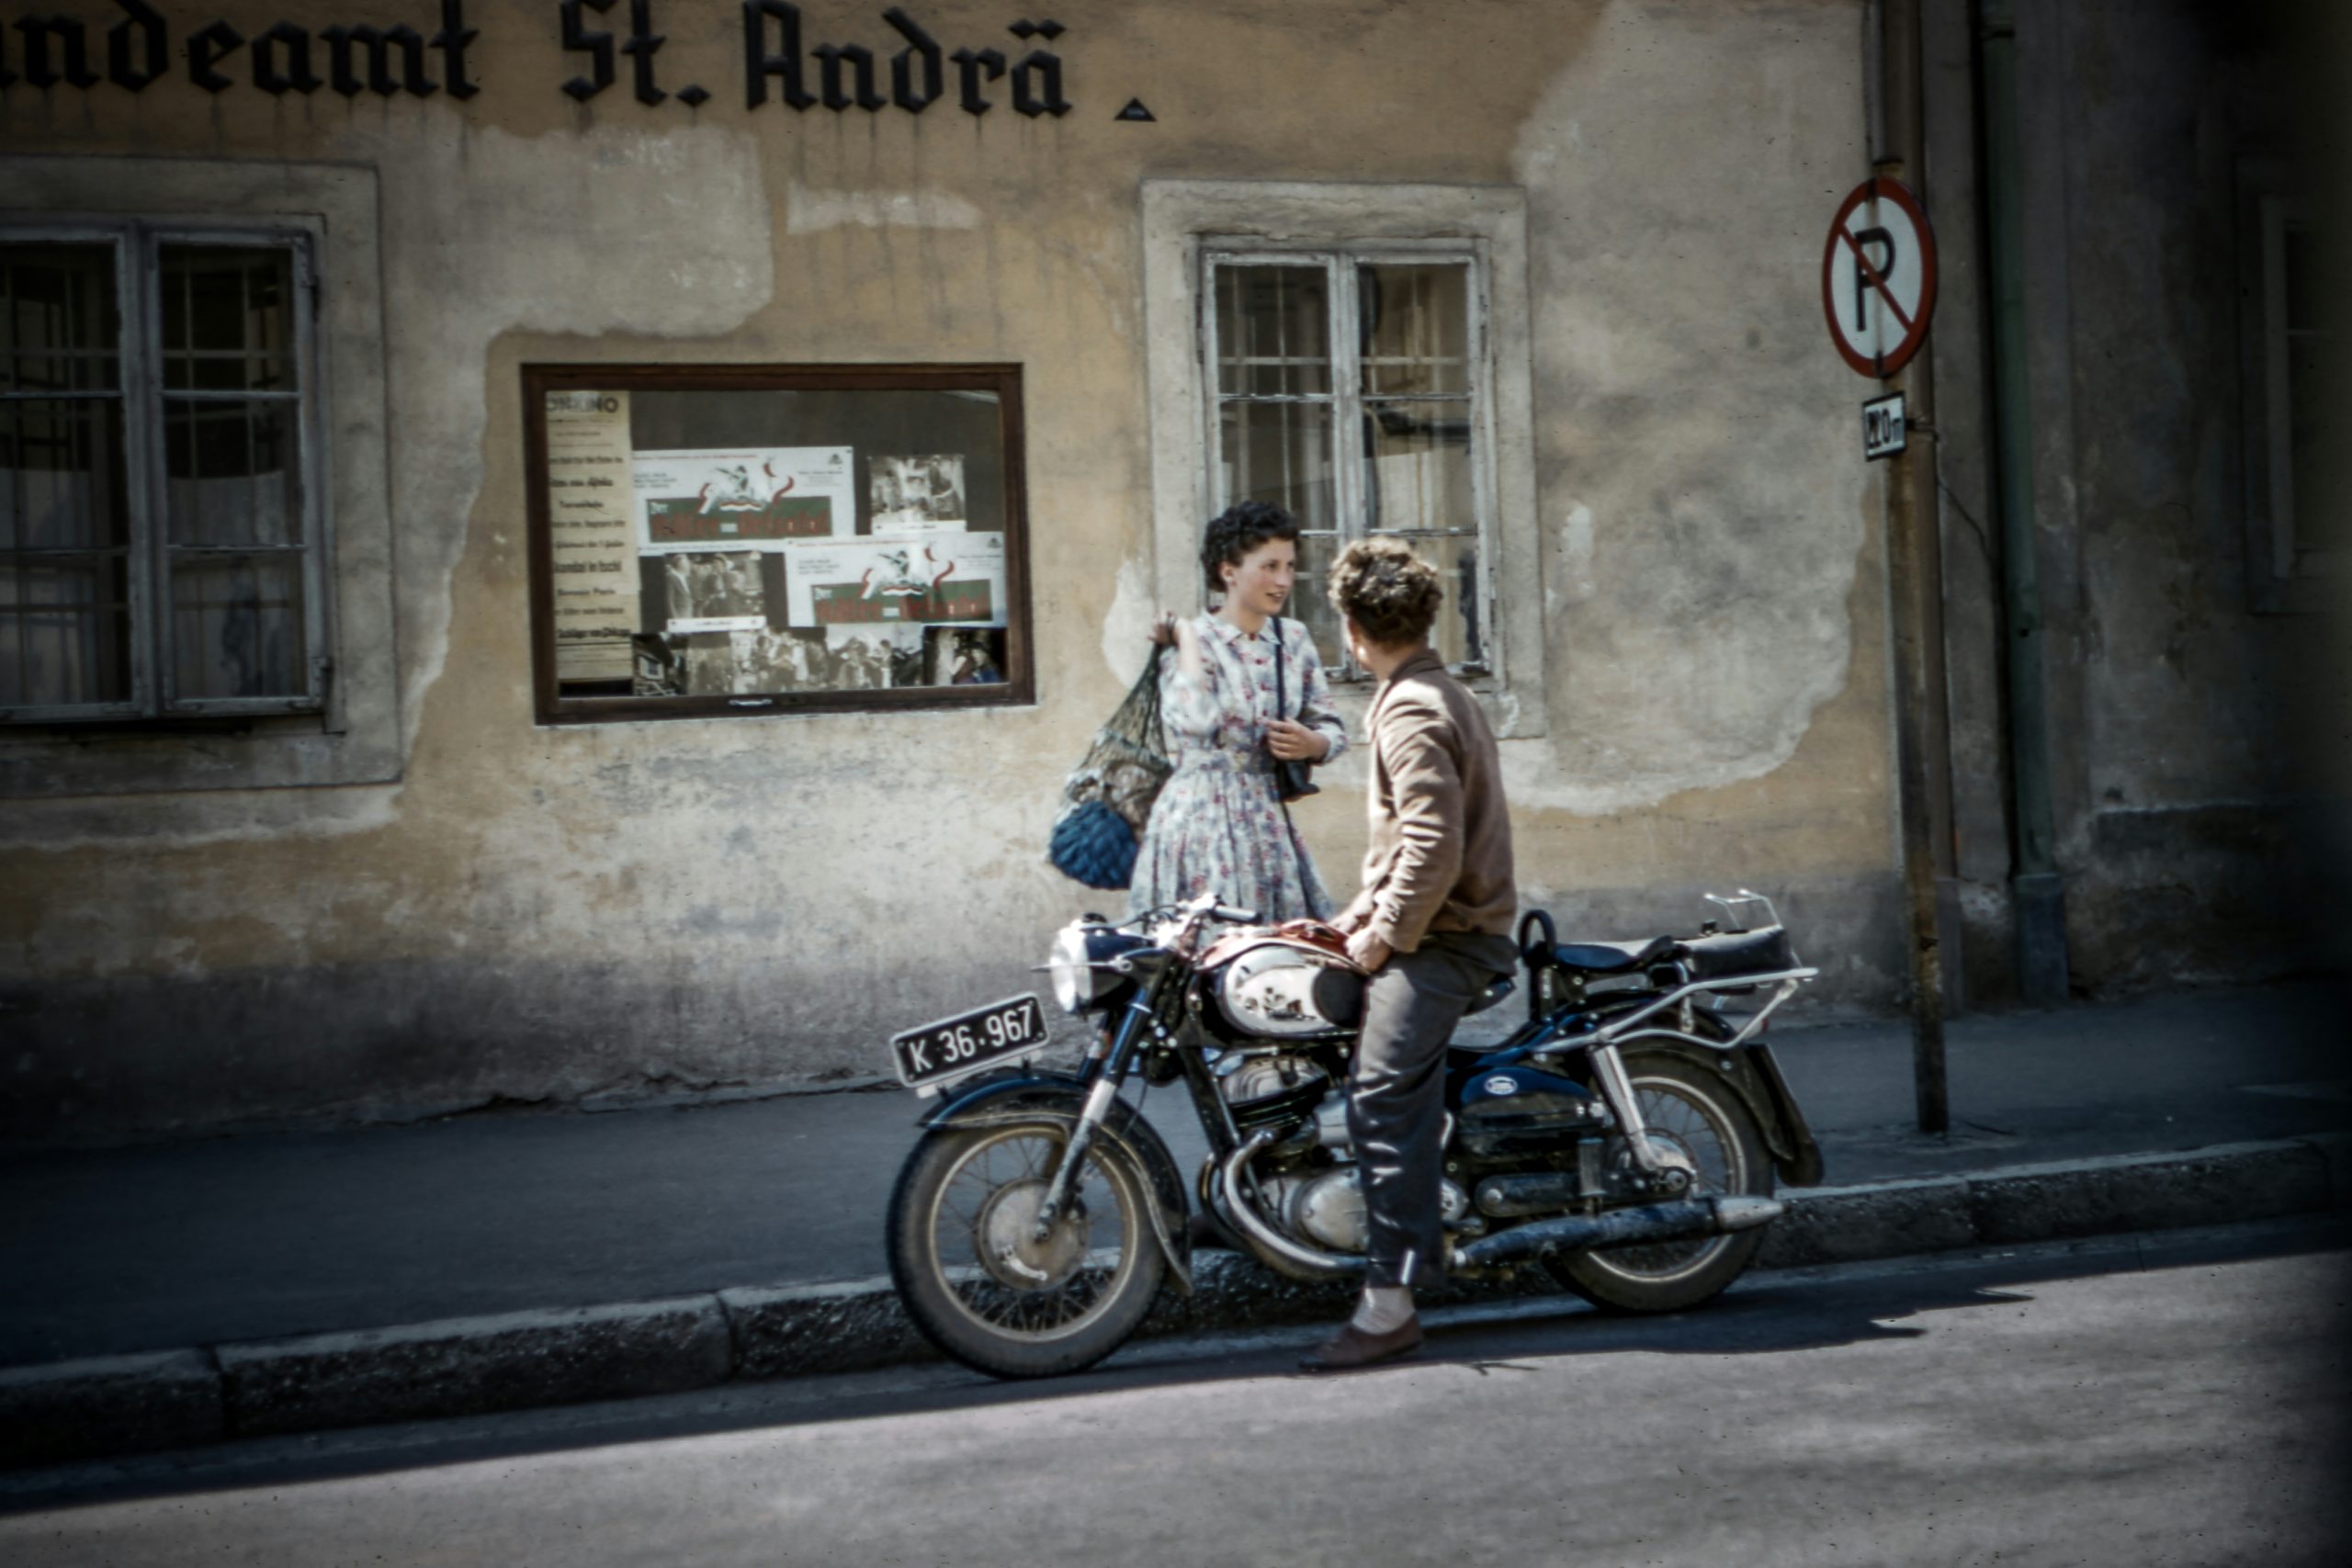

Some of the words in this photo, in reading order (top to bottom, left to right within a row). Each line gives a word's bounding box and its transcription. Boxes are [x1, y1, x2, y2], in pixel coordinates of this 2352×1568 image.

[0, 0, 481, 100] ndeamt
[560, 0, 711, 107] St.
[743, 0, 1072, 118] Andrä
[1854, 227, 1896, 333] P
[909, 1039, 933, 1073] K
[937, 1004, 1033, 1063] 36.967
